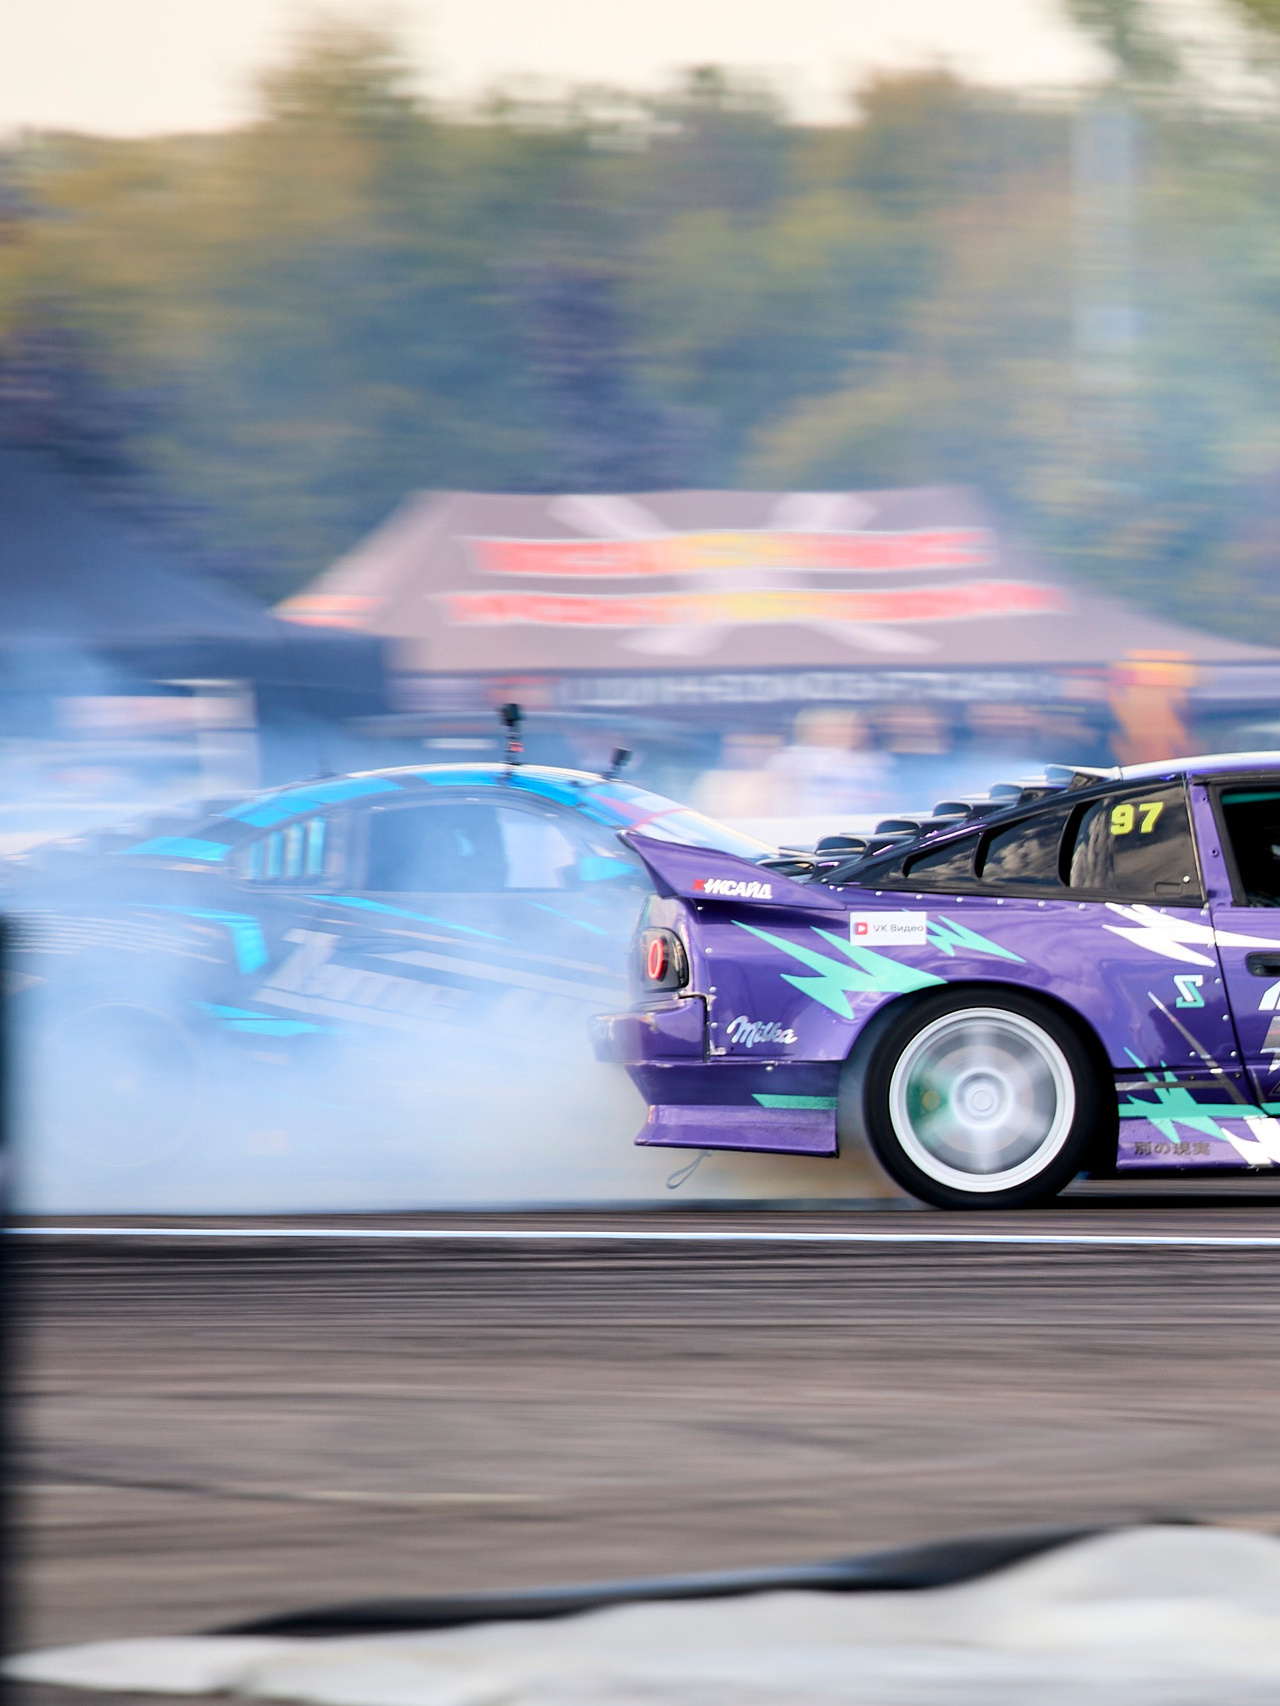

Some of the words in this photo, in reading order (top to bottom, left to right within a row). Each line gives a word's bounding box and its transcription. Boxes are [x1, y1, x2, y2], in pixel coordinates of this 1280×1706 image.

[1110, 801, 1164, 836] 97
[873, 924, 887, 932] VK
[890, 924, 924, 932] Видео
[726, 1014, 798, 1048] Milka
